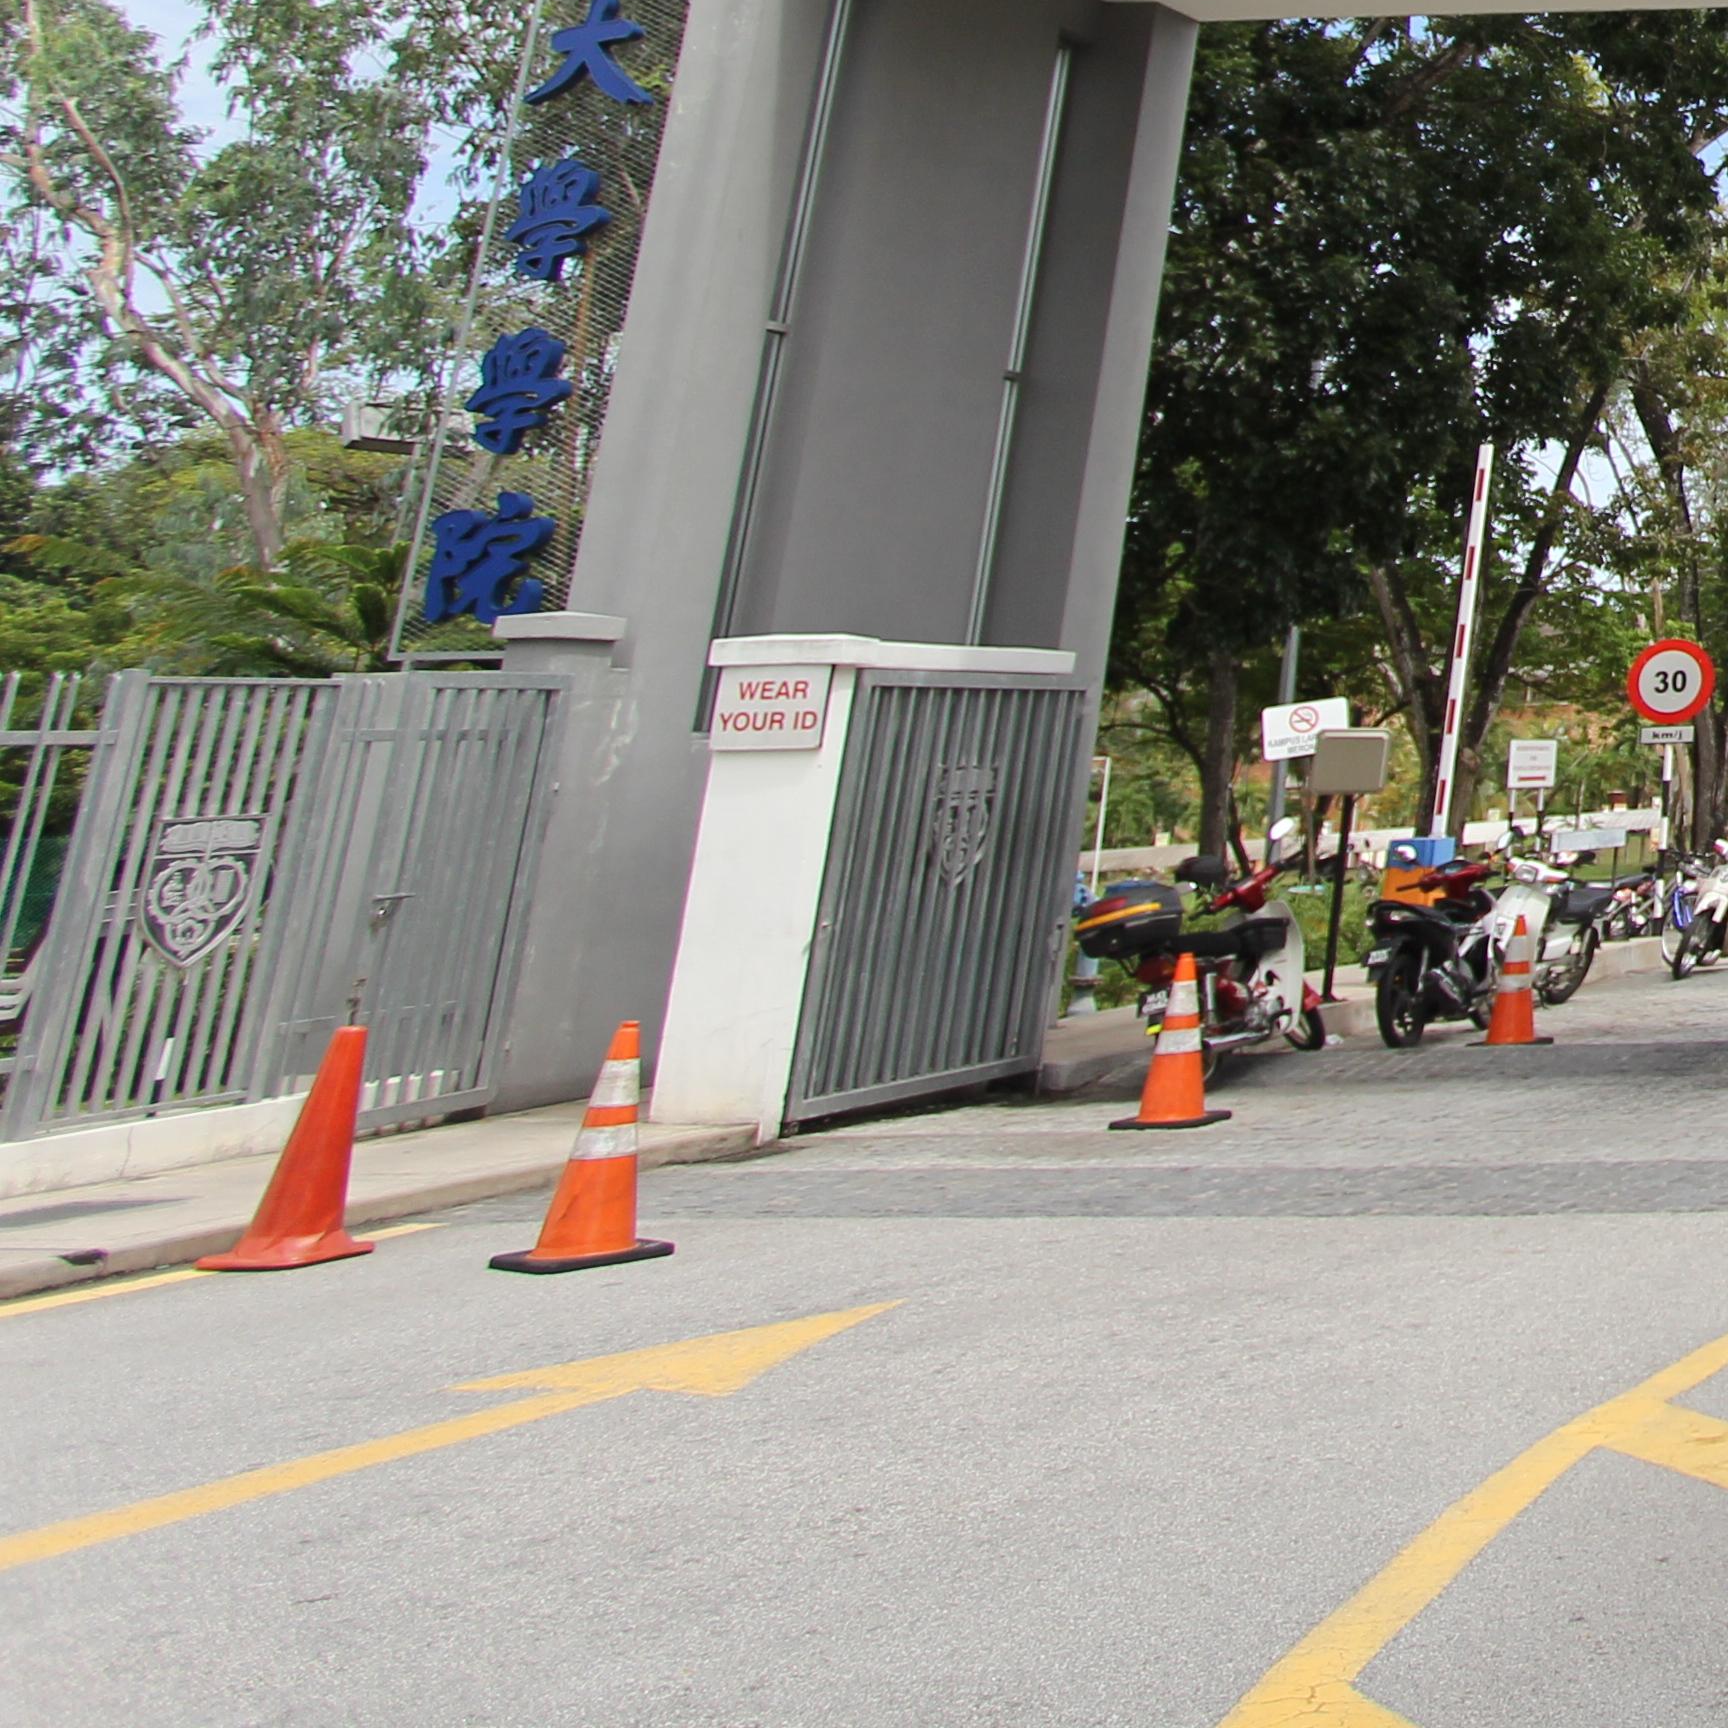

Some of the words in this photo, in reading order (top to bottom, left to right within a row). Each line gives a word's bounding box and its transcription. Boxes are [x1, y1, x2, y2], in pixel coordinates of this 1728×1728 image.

[739, 680, 809, 700] WEAR
[1654, 670, 1687, 694] 30
[720, 712, 785, 731] YOUR
[793, 711, 818, 730] ID
[1652, 730, 1682, 740] km/j
